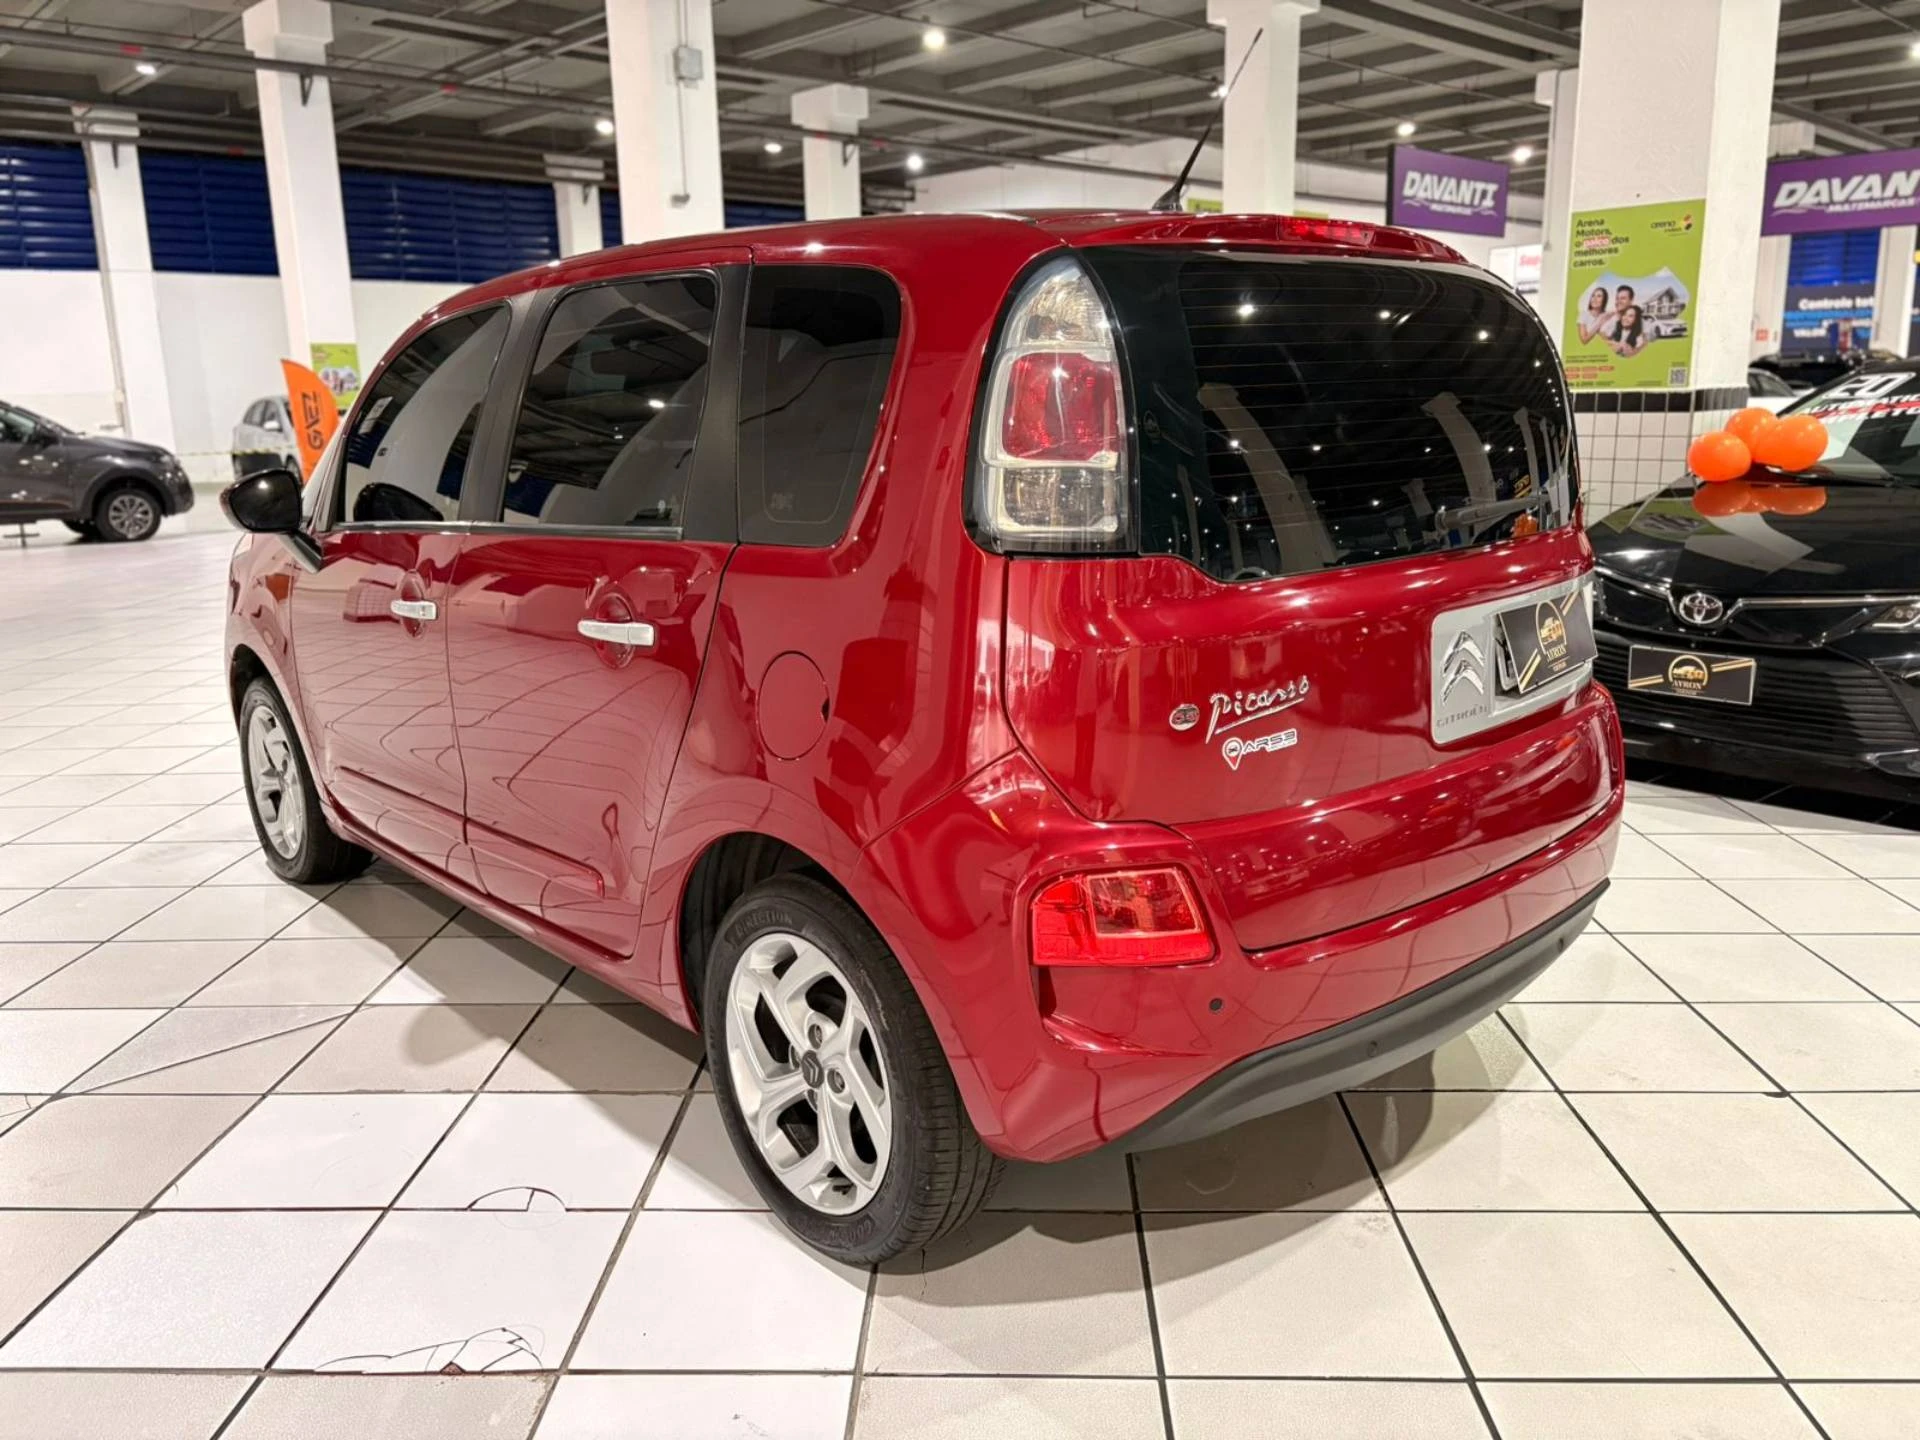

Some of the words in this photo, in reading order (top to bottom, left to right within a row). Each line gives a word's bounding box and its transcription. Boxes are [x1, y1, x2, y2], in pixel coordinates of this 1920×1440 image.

[1402, 169, 1498, 208] DAVANTI
[1773, 169, 1920, 208] DAVAN
[1576, 218, 1605, 228] Arena
[1611, 236, 1630, 245] dos
[1574, 246, 1619, 257] melhores
[1798, 297, 1854, 310] Controle
